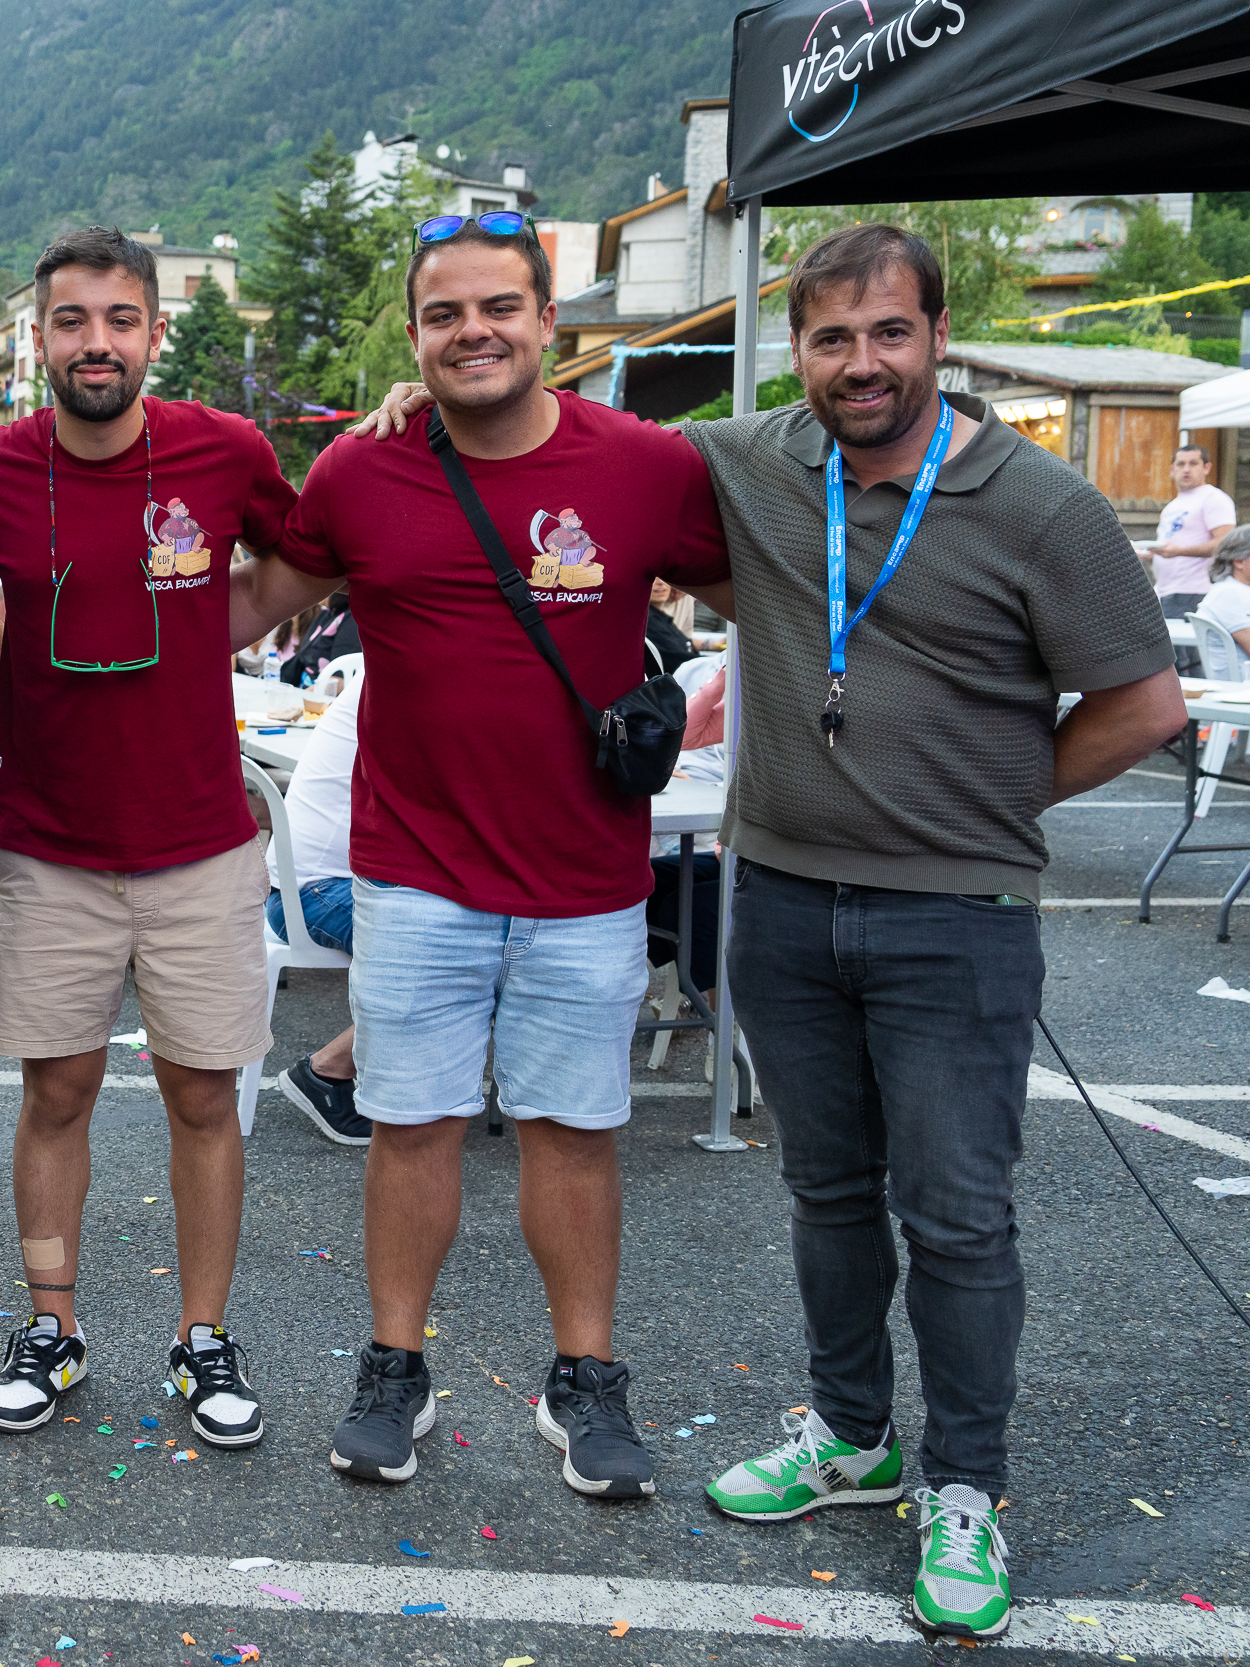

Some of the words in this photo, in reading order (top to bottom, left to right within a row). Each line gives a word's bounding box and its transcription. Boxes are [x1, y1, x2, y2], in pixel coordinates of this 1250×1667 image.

[782, 0, 965, 108] vtècnics
[835, 526, 843, 557] Encamp
[887, 535, 905, 566] Encamp
[157, 555, 171, 565] CDF
[540, 565, 555, 576] CDF
[145, 580, 174, 592] VISCA
[556, 592, 603, 604] ENCAMP!
